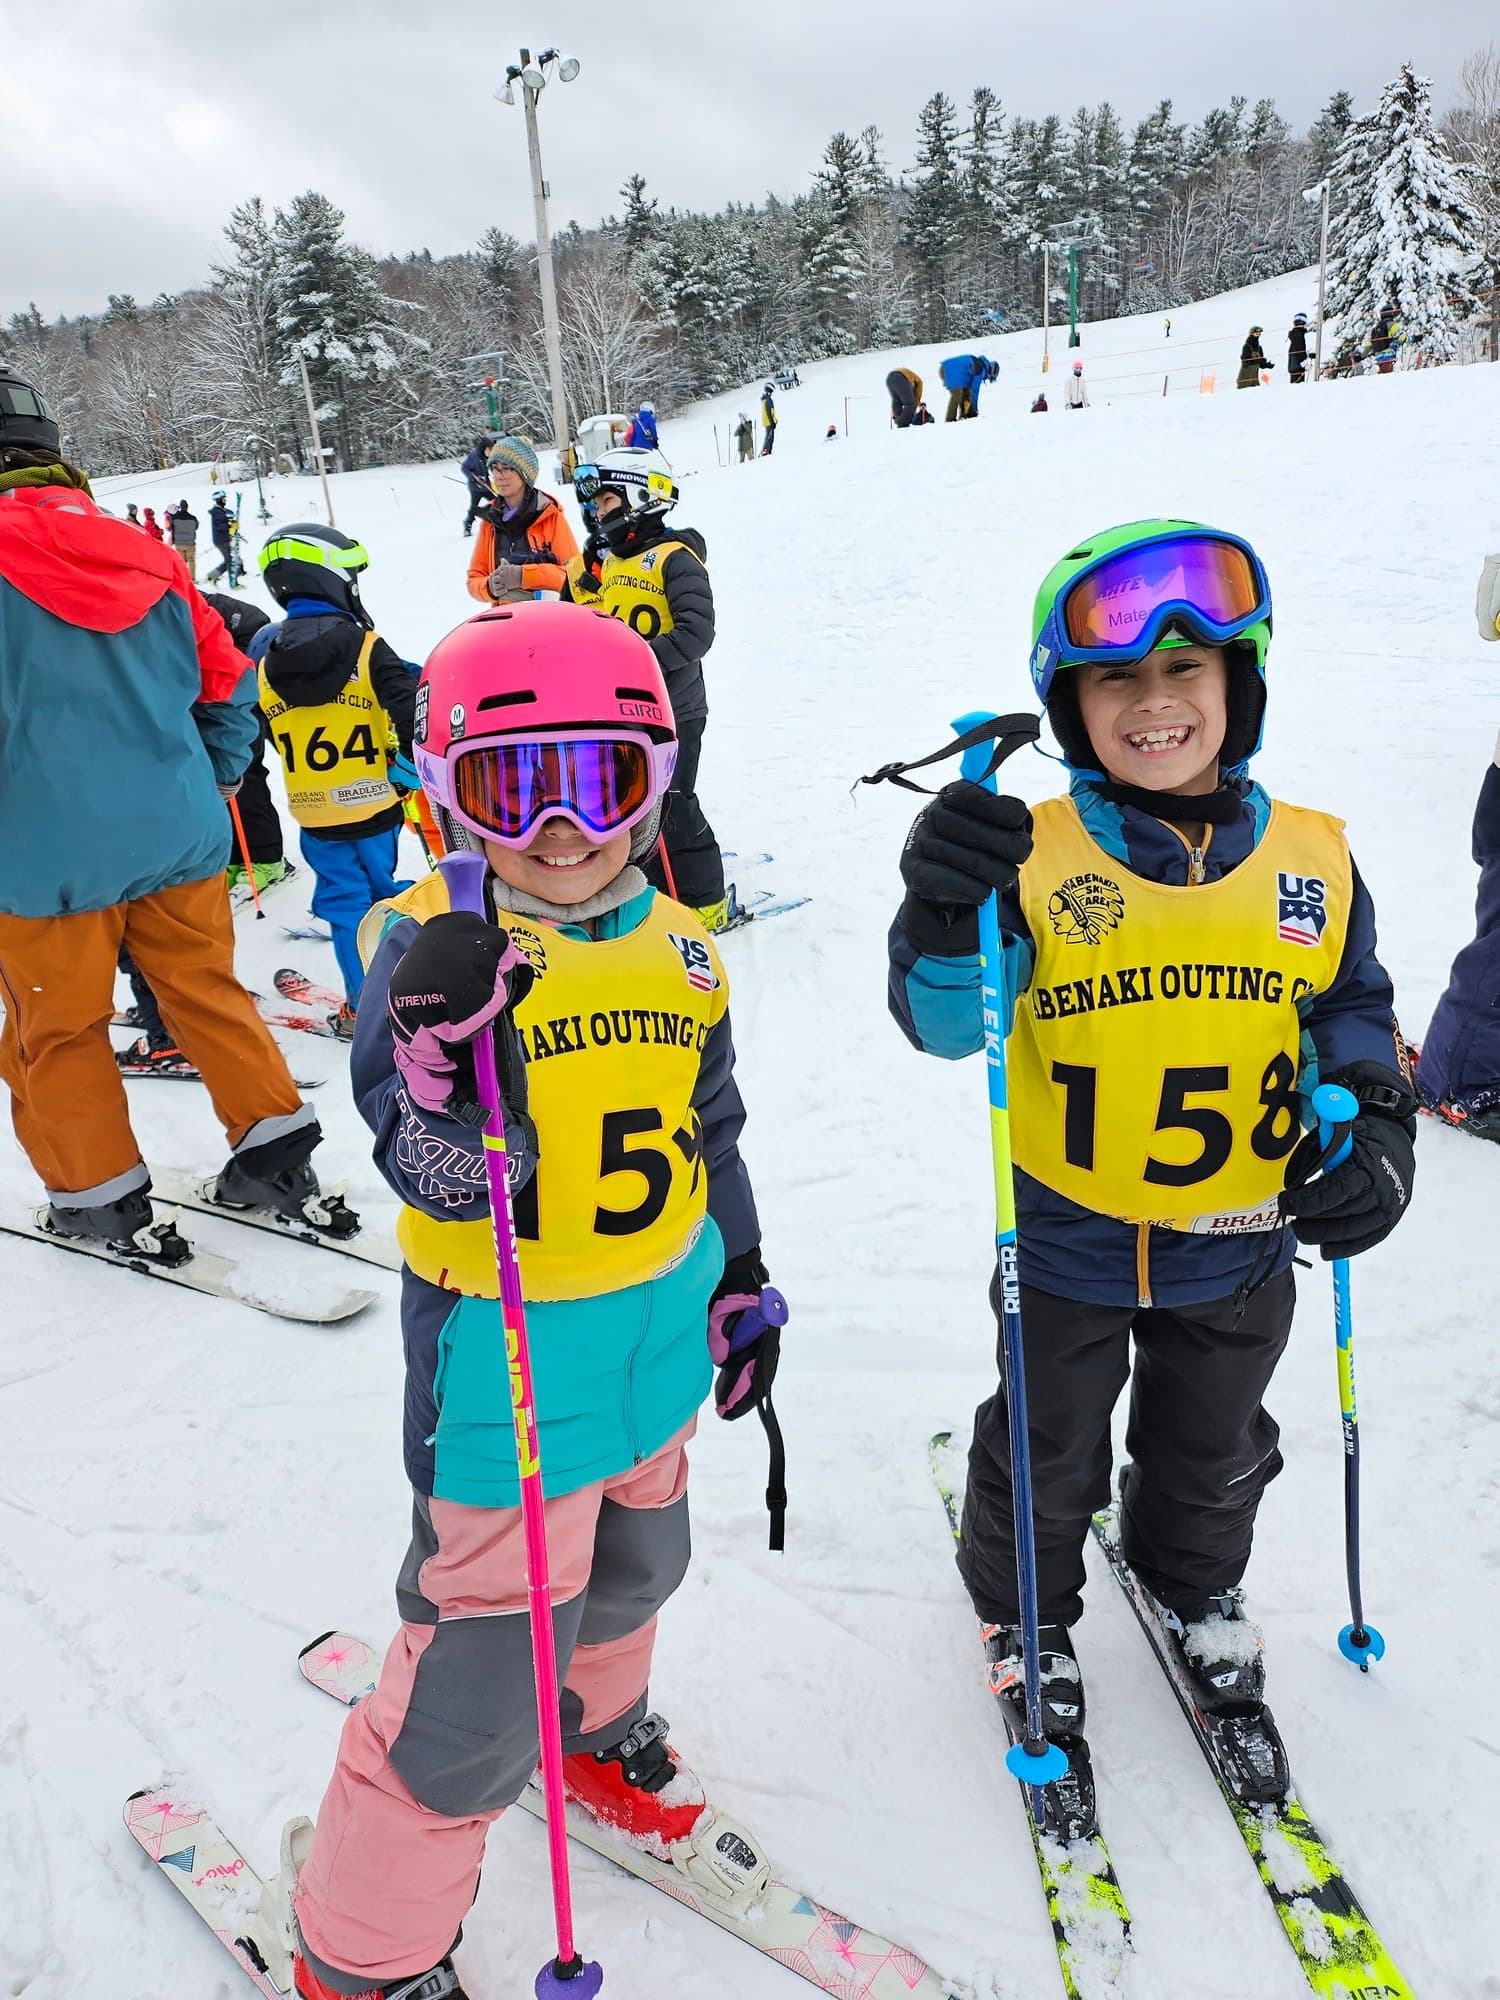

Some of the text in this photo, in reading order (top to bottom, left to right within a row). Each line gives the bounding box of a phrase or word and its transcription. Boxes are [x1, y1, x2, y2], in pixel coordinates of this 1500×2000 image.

[619, 703, 662, 720] GIRO
[278, 724, 379, 773] 164
[337, 782, 389, 798] BRADLEY'S
[1070, 873, 1113, 890] ABENAKI
[1086, 886, 1103, 894] SKI
[1278, 873, 1324, 903] US
[1085, 896, 1110, 909] AREA
[1160, 964, 1283, 1004] OUTING
[590, 1010, 693, 1049] OUTING
[981, 985, 999, 1067] LEKI
[1051, 1051, 1300, 1187] 158
[1380, 1155, 1404, 1198] Columbia
[1001, 1246, 1019, 1314] RIDER
